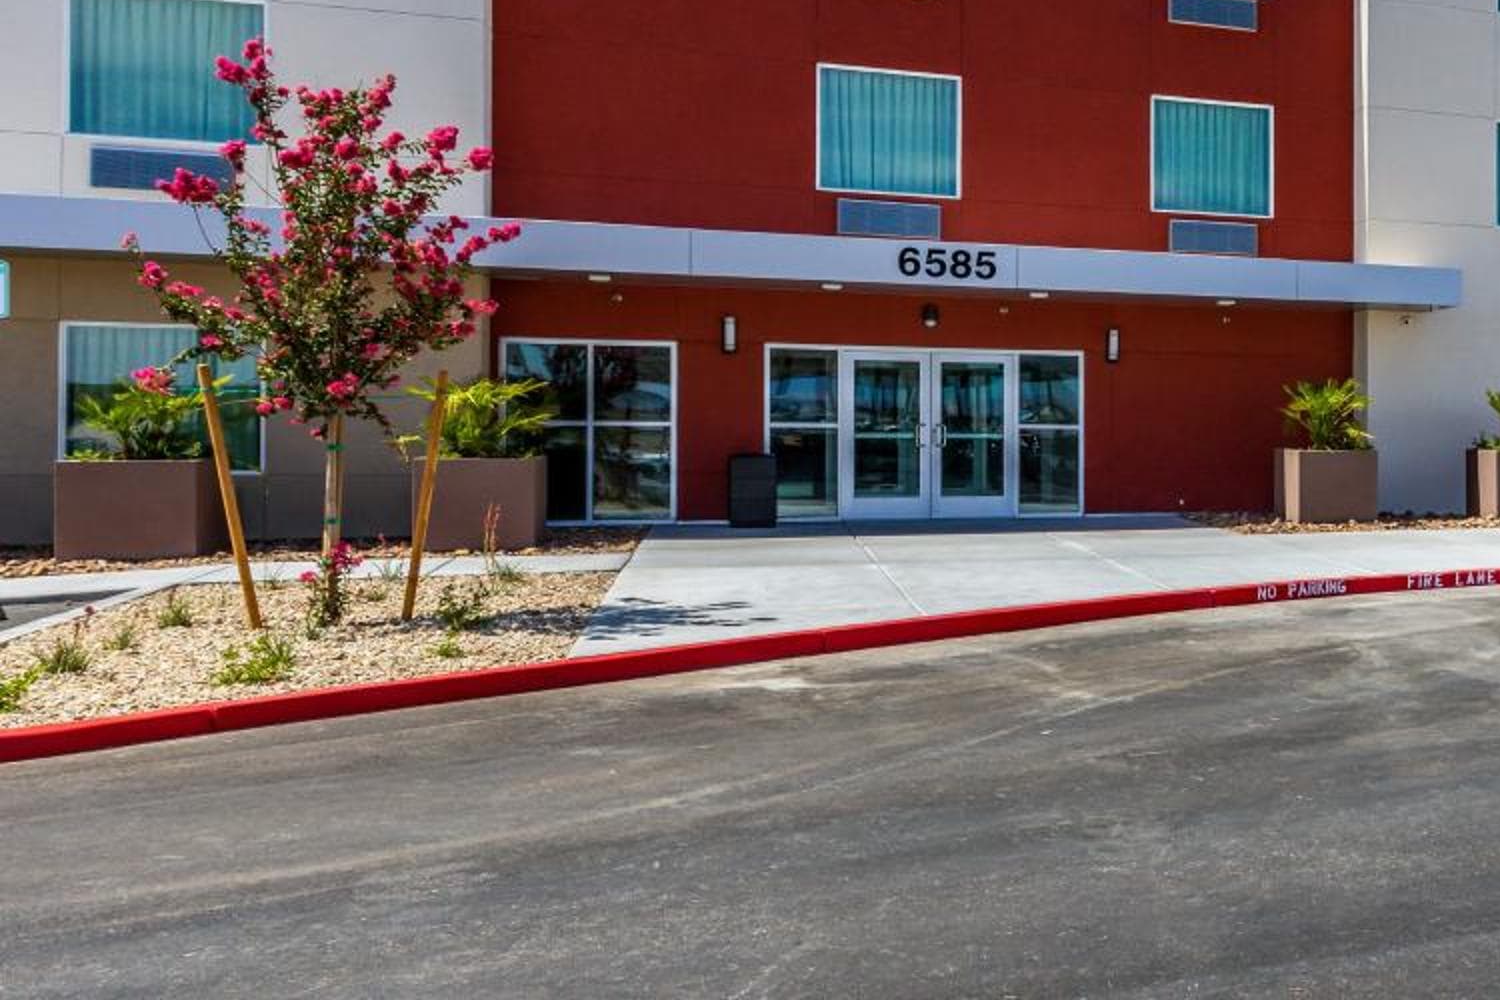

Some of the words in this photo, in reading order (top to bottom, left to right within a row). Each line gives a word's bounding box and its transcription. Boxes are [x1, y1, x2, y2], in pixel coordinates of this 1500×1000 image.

[898, 246, 997, 279] 6585
[1408, 572, 1444, 590] FIRE
[1455, 569, 1497, 588] LANE
[1257, 584, 1278, 601] NO
[1287, 580, 1347, 599] PARKING
